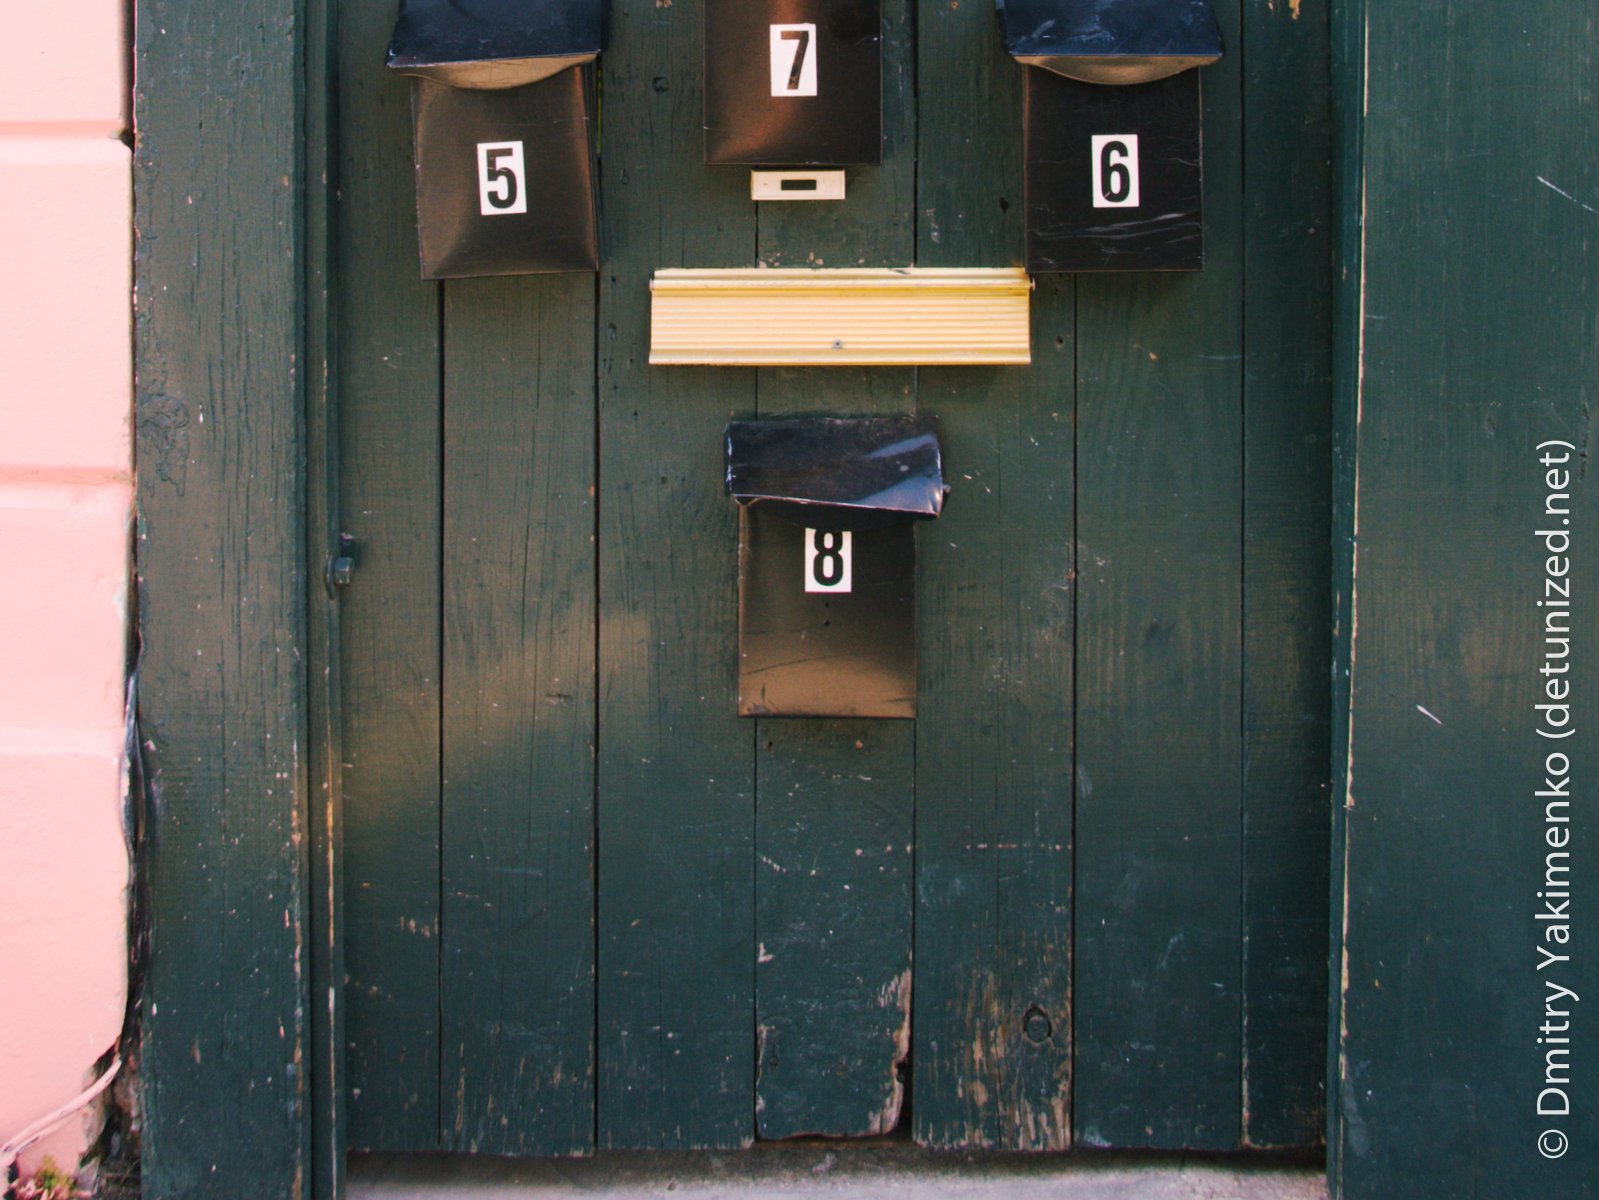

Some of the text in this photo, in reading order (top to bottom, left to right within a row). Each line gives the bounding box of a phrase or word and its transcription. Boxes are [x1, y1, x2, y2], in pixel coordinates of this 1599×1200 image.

[779, 30, 810, 90] 7
[486, 148, 518, 209] 5
[1100, 141, 1131, 203] 6
[813, 529, 844, 587] 8
